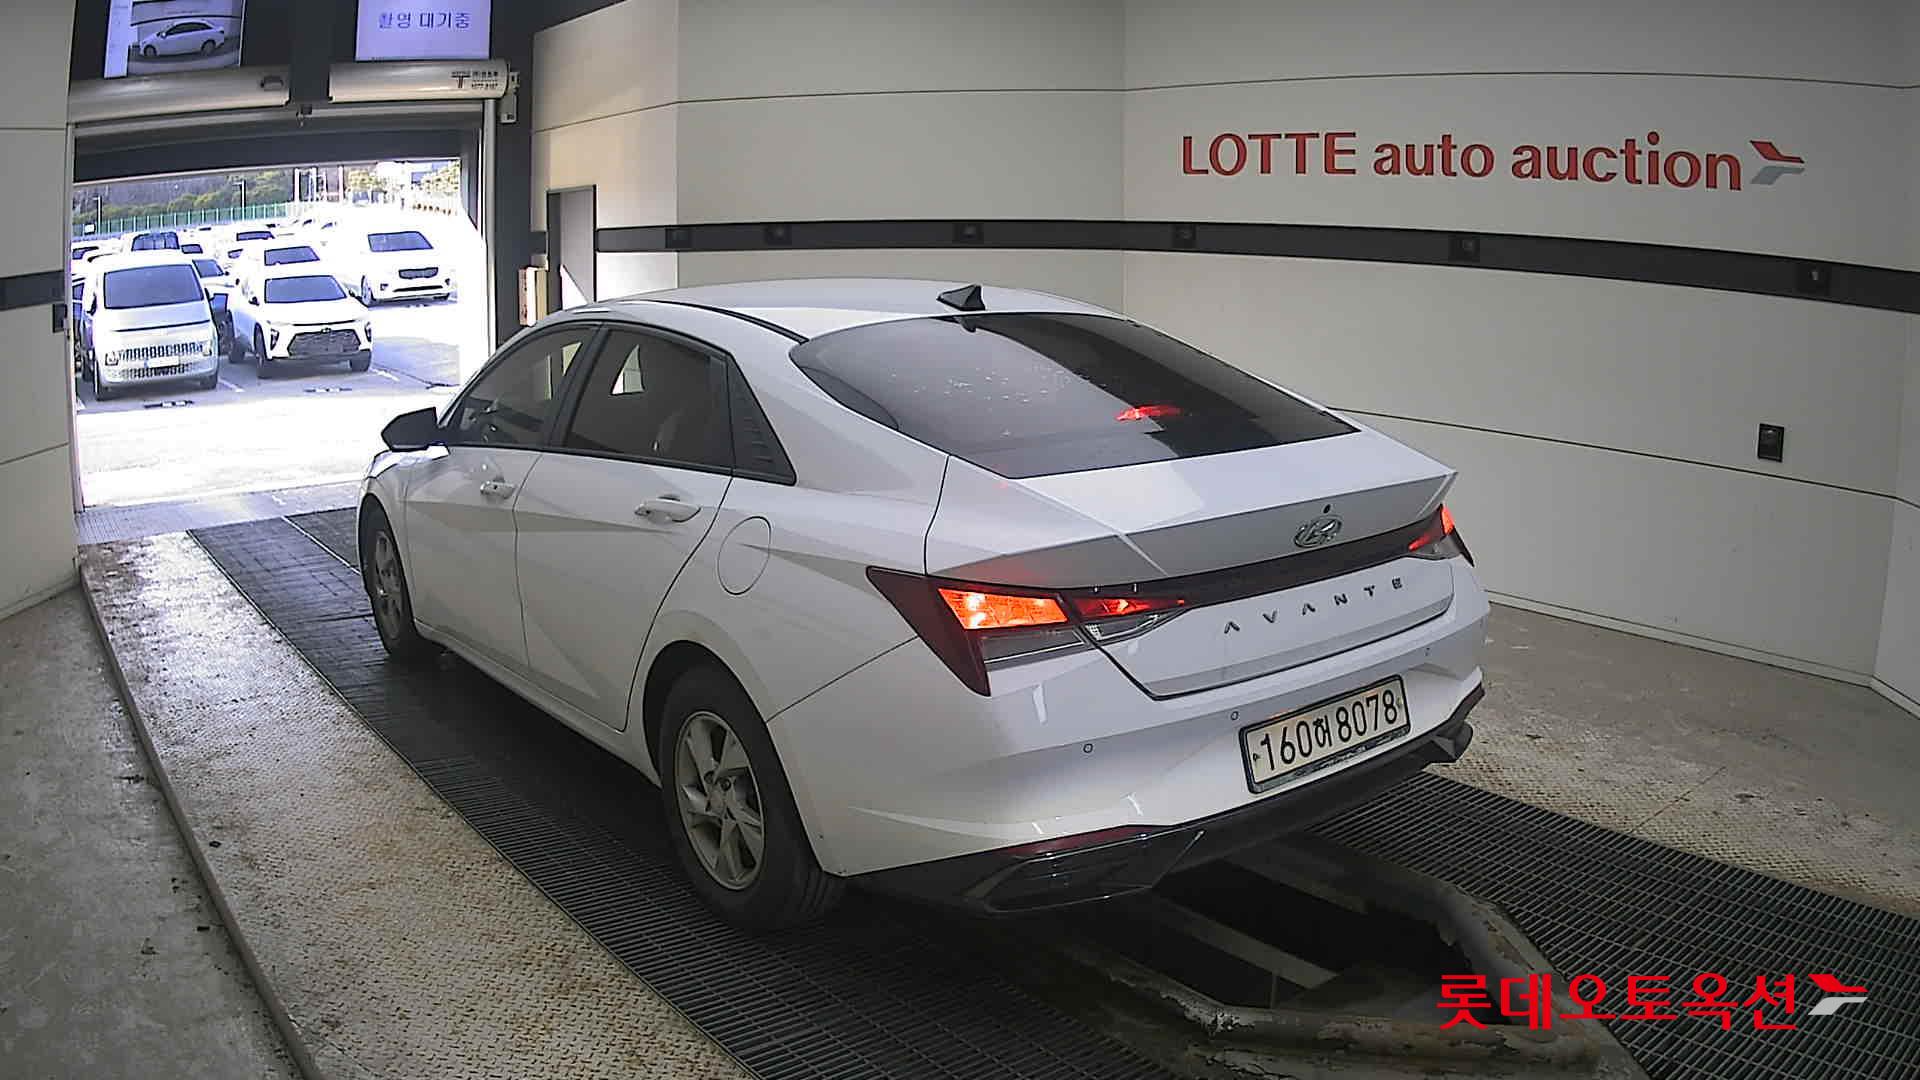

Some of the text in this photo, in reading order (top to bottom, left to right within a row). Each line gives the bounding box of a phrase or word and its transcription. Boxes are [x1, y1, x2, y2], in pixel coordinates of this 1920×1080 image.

[419, 12, 471, 29] 대기중
[1182, 130, 1742, 191] LOTTE auto auction
[1223, 576, 1403, 635] AVANTE
